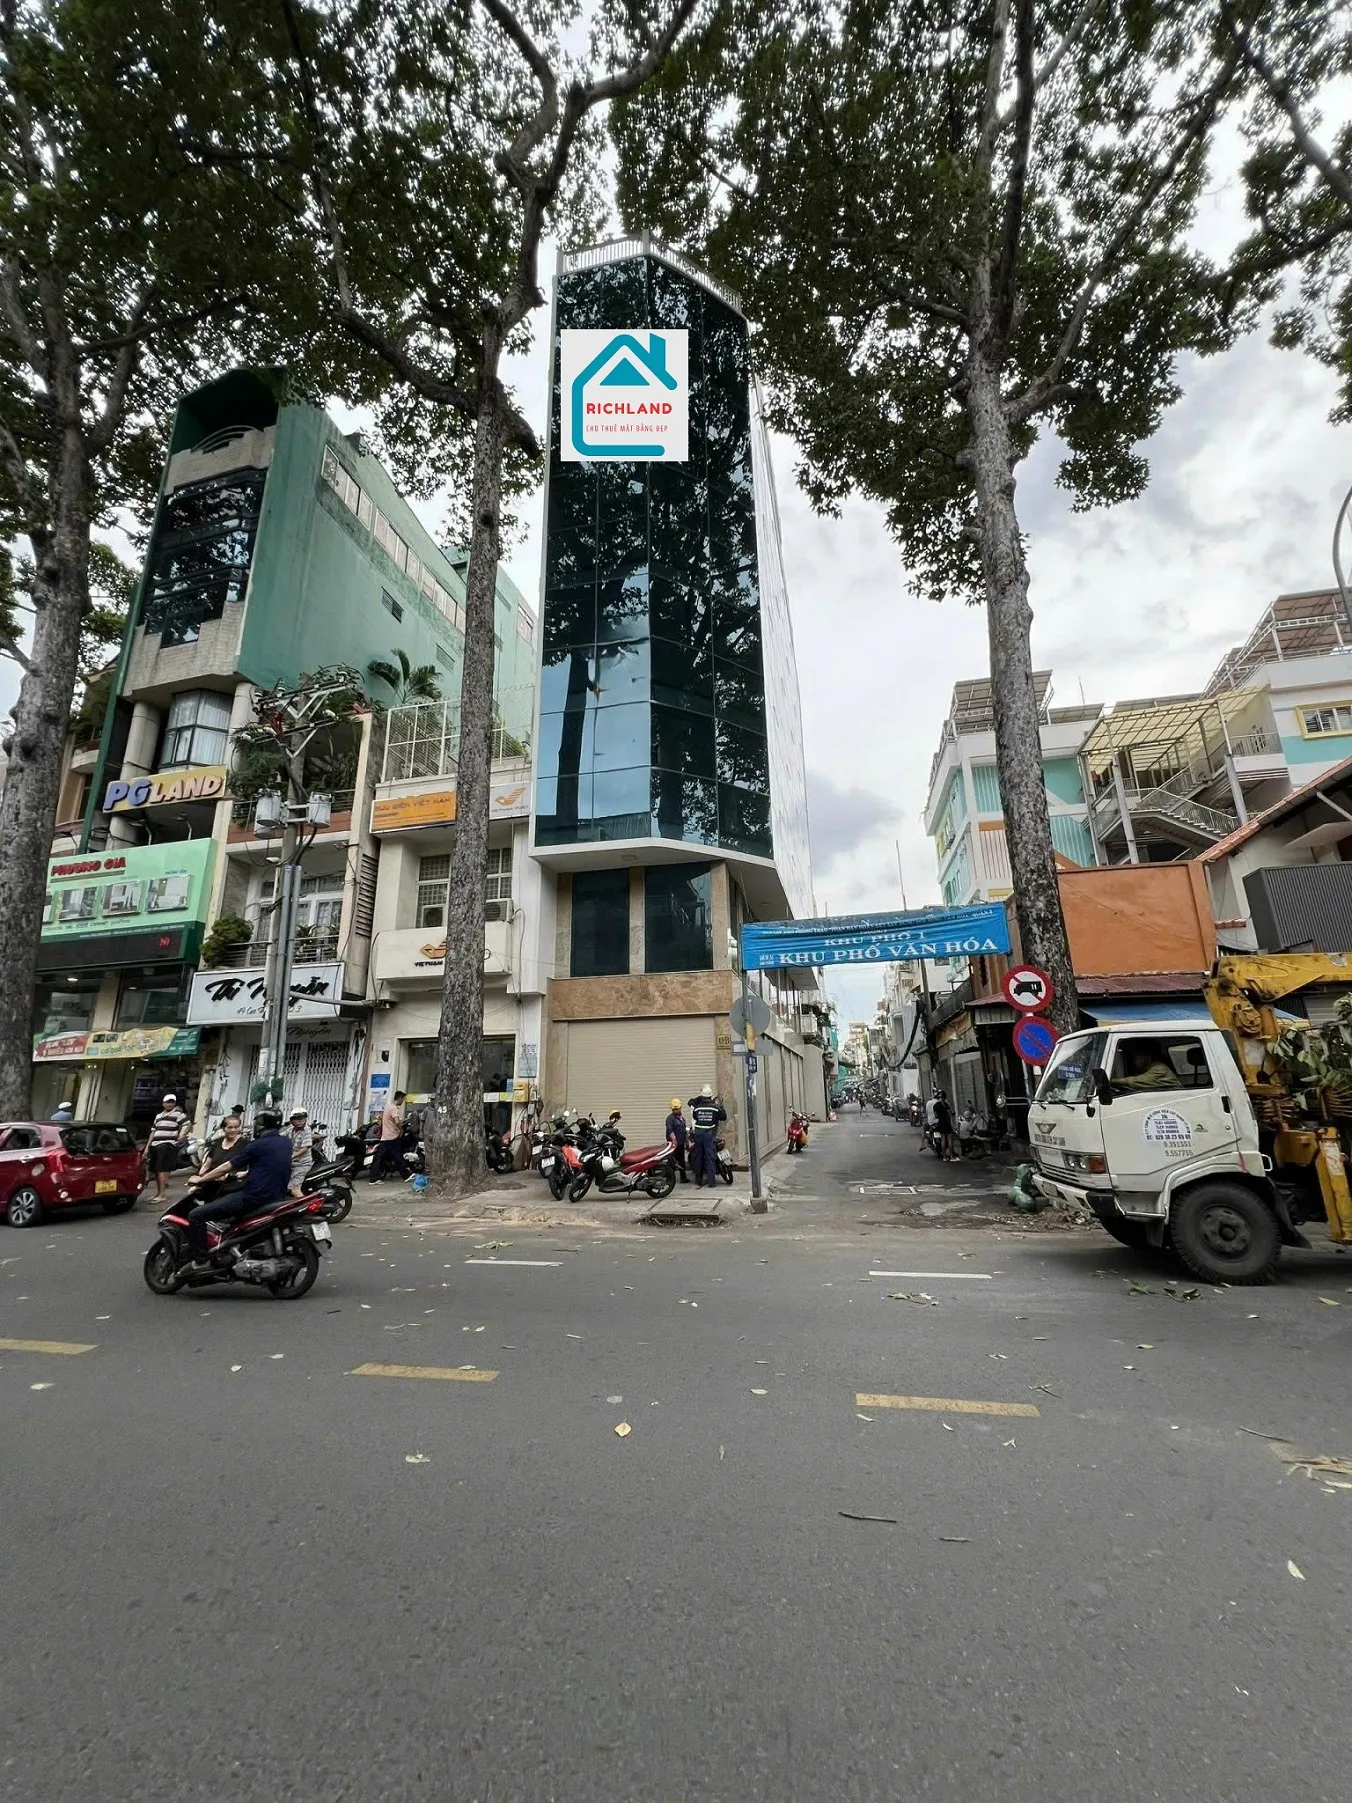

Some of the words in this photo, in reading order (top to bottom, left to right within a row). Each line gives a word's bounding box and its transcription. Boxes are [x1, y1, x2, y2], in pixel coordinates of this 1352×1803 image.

[779, 951, 826, 964] KHU
[832, 942, 881, 961] PHỐ
[887, 942, 937, 957] VĂN
[944, 936, 998, 953] HÓA
[437, 1106, 448, 1114] 45
